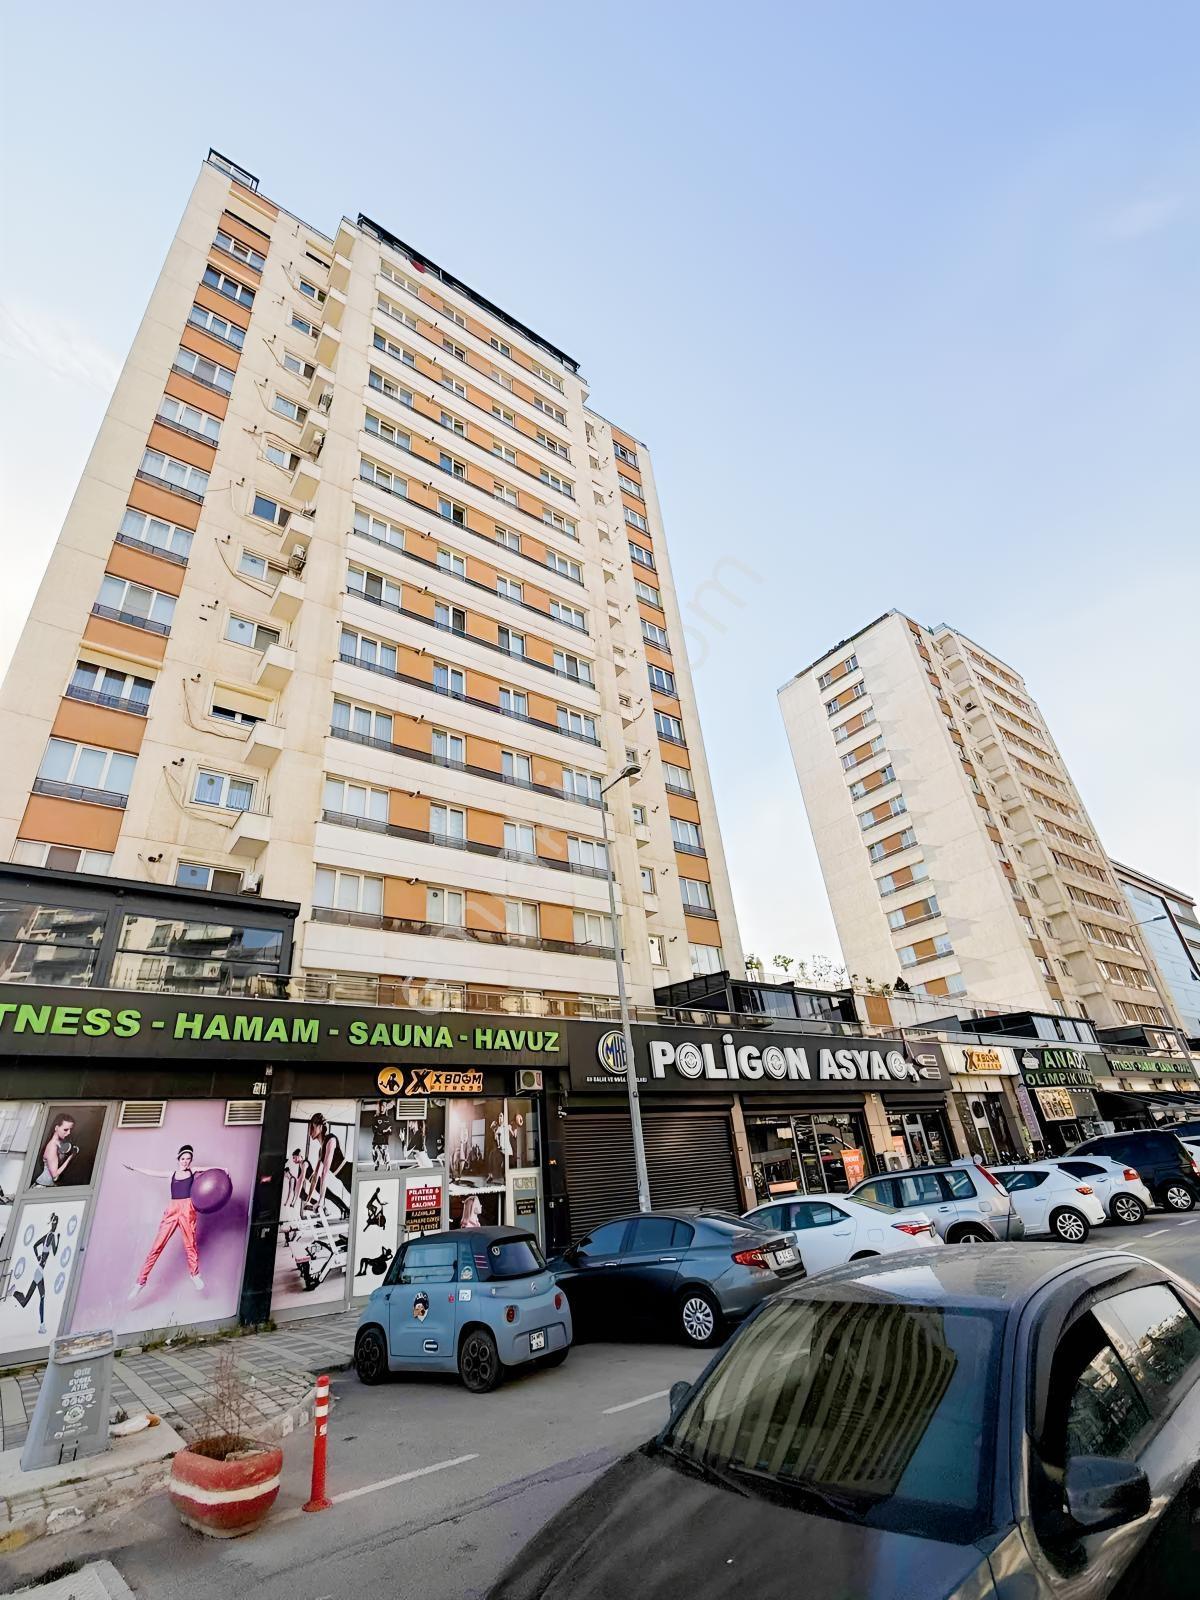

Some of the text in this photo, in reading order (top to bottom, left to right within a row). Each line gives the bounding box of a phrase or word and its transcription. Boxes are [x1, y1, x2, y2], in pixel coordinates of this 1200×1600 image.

[173, 1012, 320, 1044] HAMAM
[348, 1021, 454, 1048] SAUNA
[475, 1028, 560, 1052] HAVUZ
